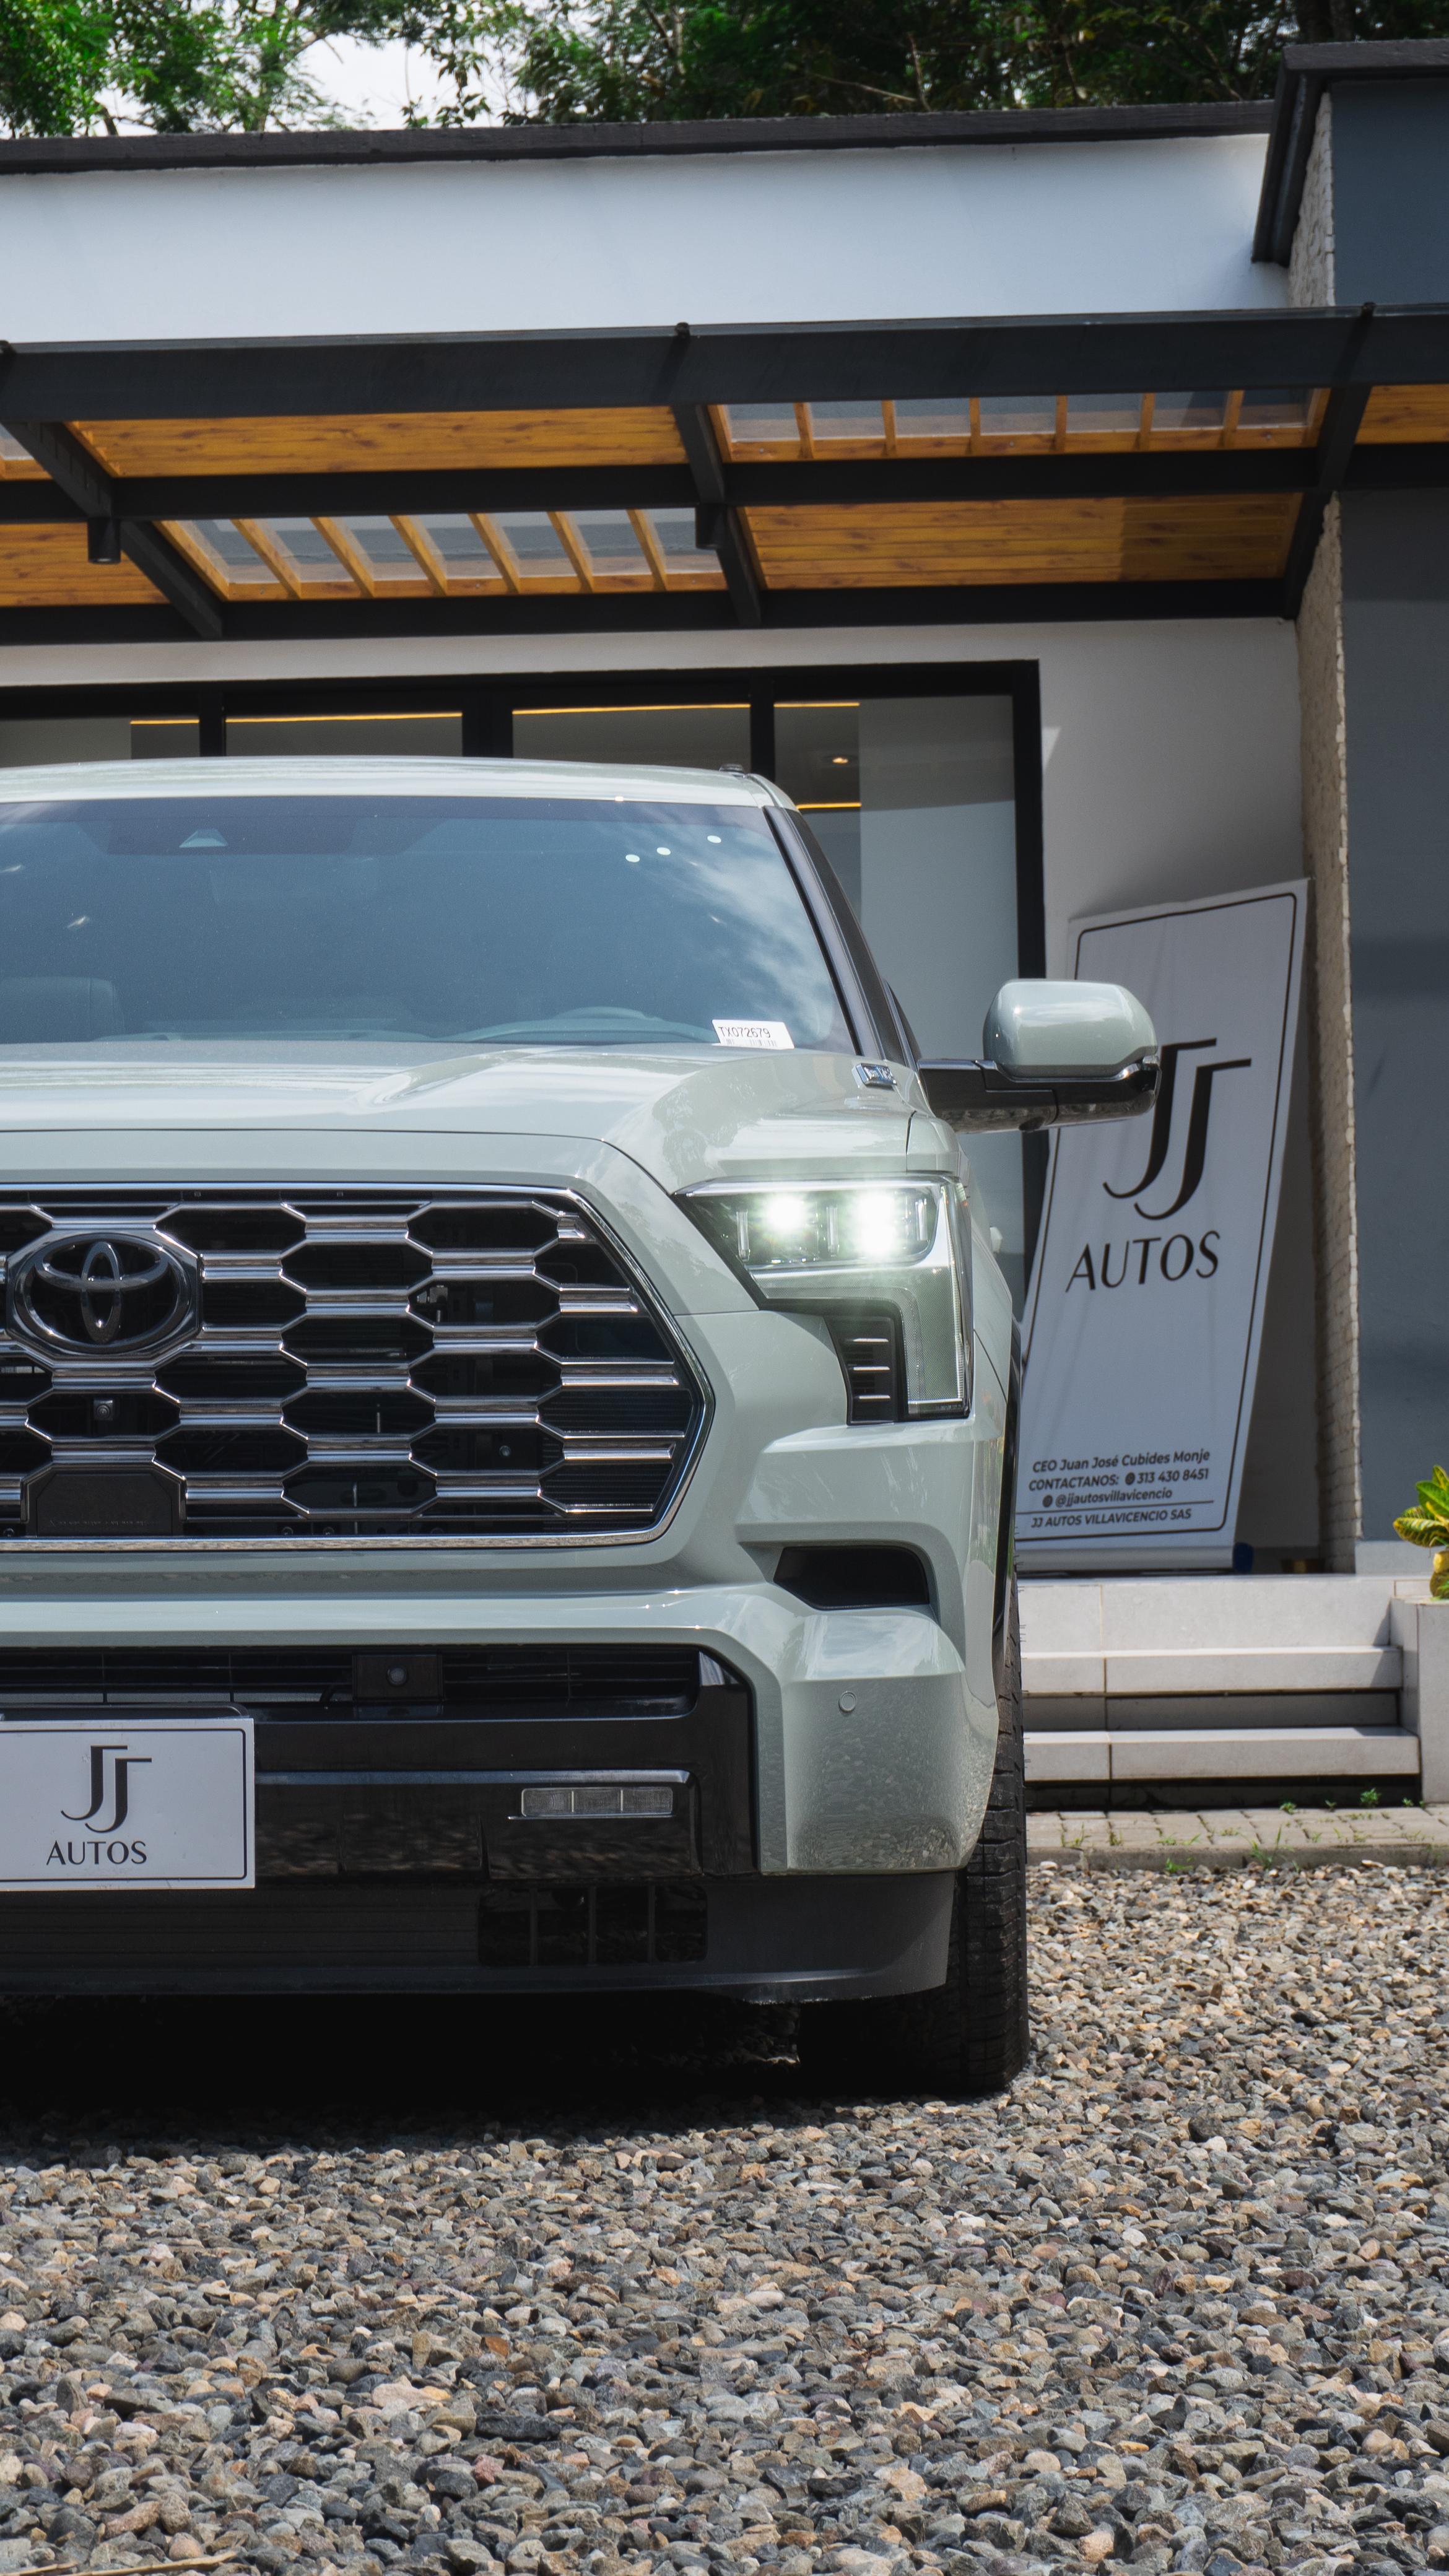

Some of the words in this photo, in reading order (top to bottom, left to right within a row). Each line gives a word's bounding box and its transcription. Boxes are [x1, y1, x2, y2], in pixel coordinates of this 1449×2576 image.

[718, 1026, 772, 1038] TX072679
[1103, 1038, 1251, 1221] JJ
[1065, 1230, 1221, 1293] AUTOS
[1033, 1460, 1057, 1473] CEO
[1060, 1459, 1089, 1471] Juan
[1092, 1455, 1118, 1468] José
[1121, 1452, 1170, 1466] Cubides
[1173, 1449, 1210, 1464] Monje
[1029, 1474, 1119, 1491] CONTACTANOS:
[1137, 1472, 1155, 1484] 313
[1158, 1470, 1180, 1482] 430
[1182, 1468, 1209, 1481] 8451
[1055, 1487, 1173, 1508] @jjautosvillavicencio
[1045, 1515, 1082, 1527] AUTOS
[1085, 1509, 1167, 1525] VILLAVICENCIO
[1170, 1508, 1192, 1520] SAS
[61, 1744, 152, 1834] JJ
[46, 1840, 147, 1866] AUTOS
